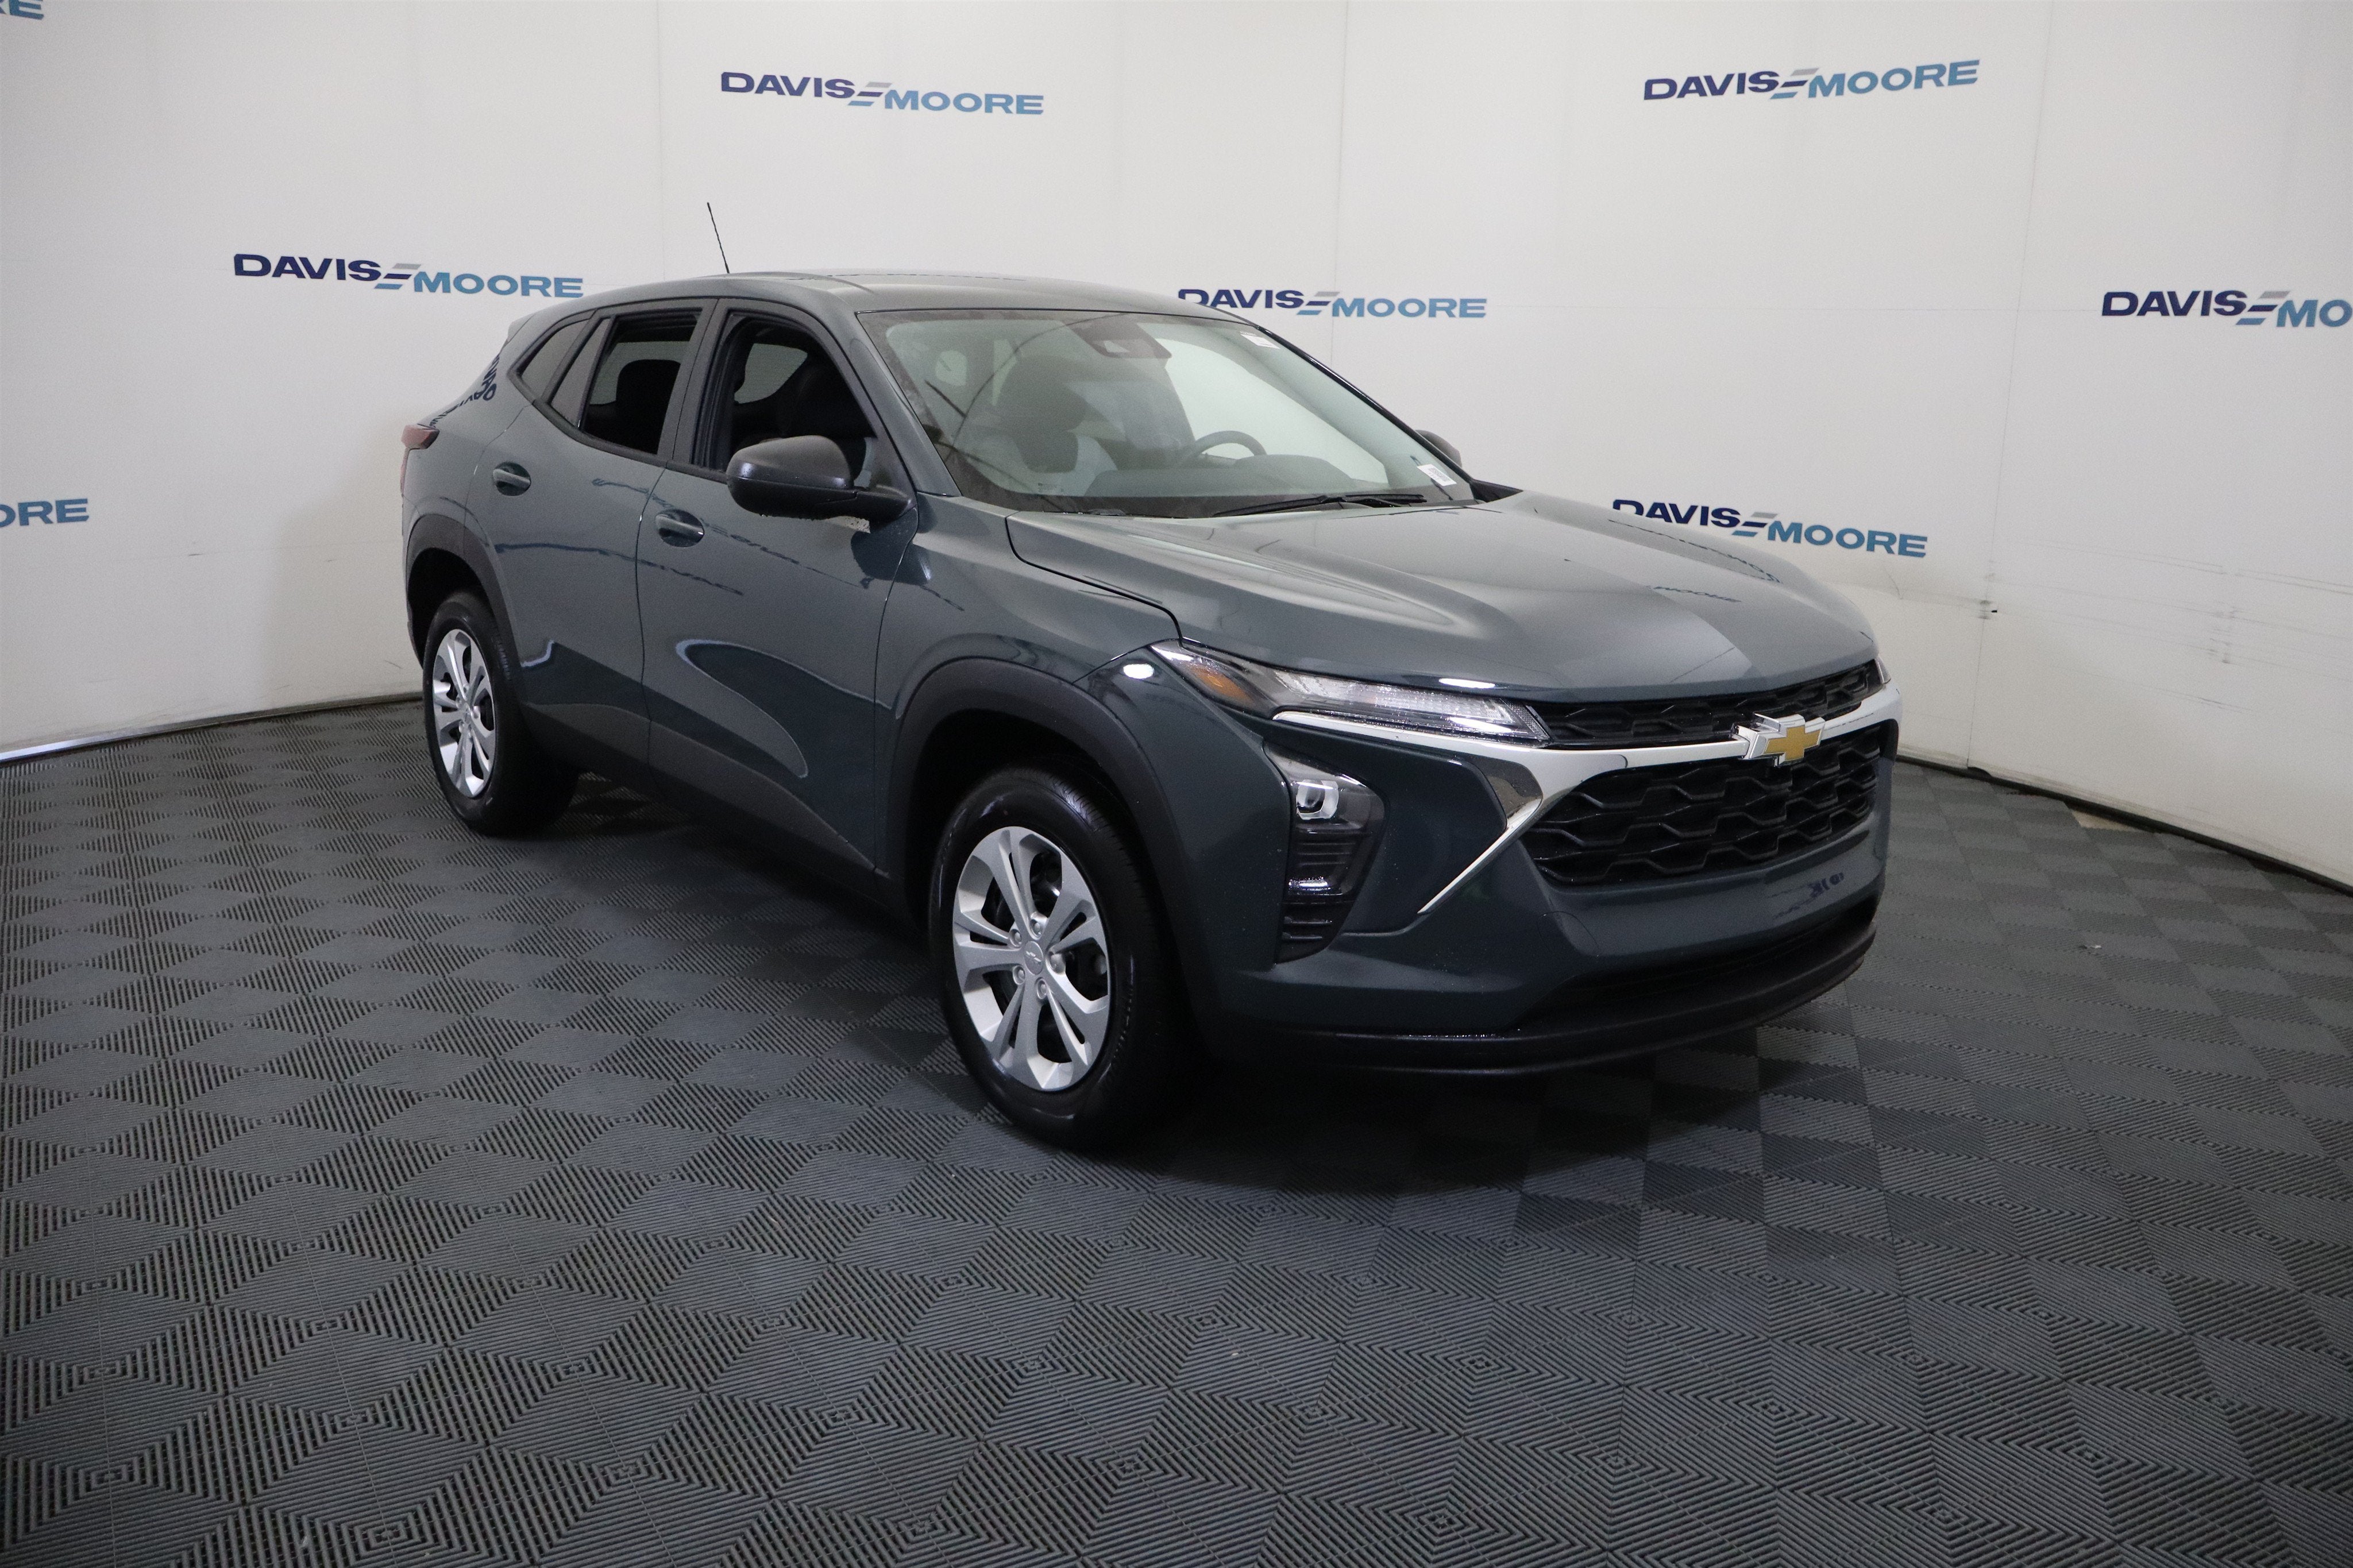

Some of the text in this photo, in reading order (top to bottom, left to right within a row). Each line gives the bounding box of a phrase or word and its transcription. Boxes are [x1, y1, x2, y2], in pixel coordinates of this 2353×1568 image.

[0, 0, 44, 20] E
[720, 72, 1044, 115] DAVIS MOORE
[1644, 59, 1980, 100] DAVIS MOORE
[234, 253, 584, 299] DAVIS MOORE
[1178, 288, 1487, 318] DAVIS MOORE
[2101, 289, 2353, 327] DAVIS MO
[1612, 498, 1927, 558] DAVIS MOORE
